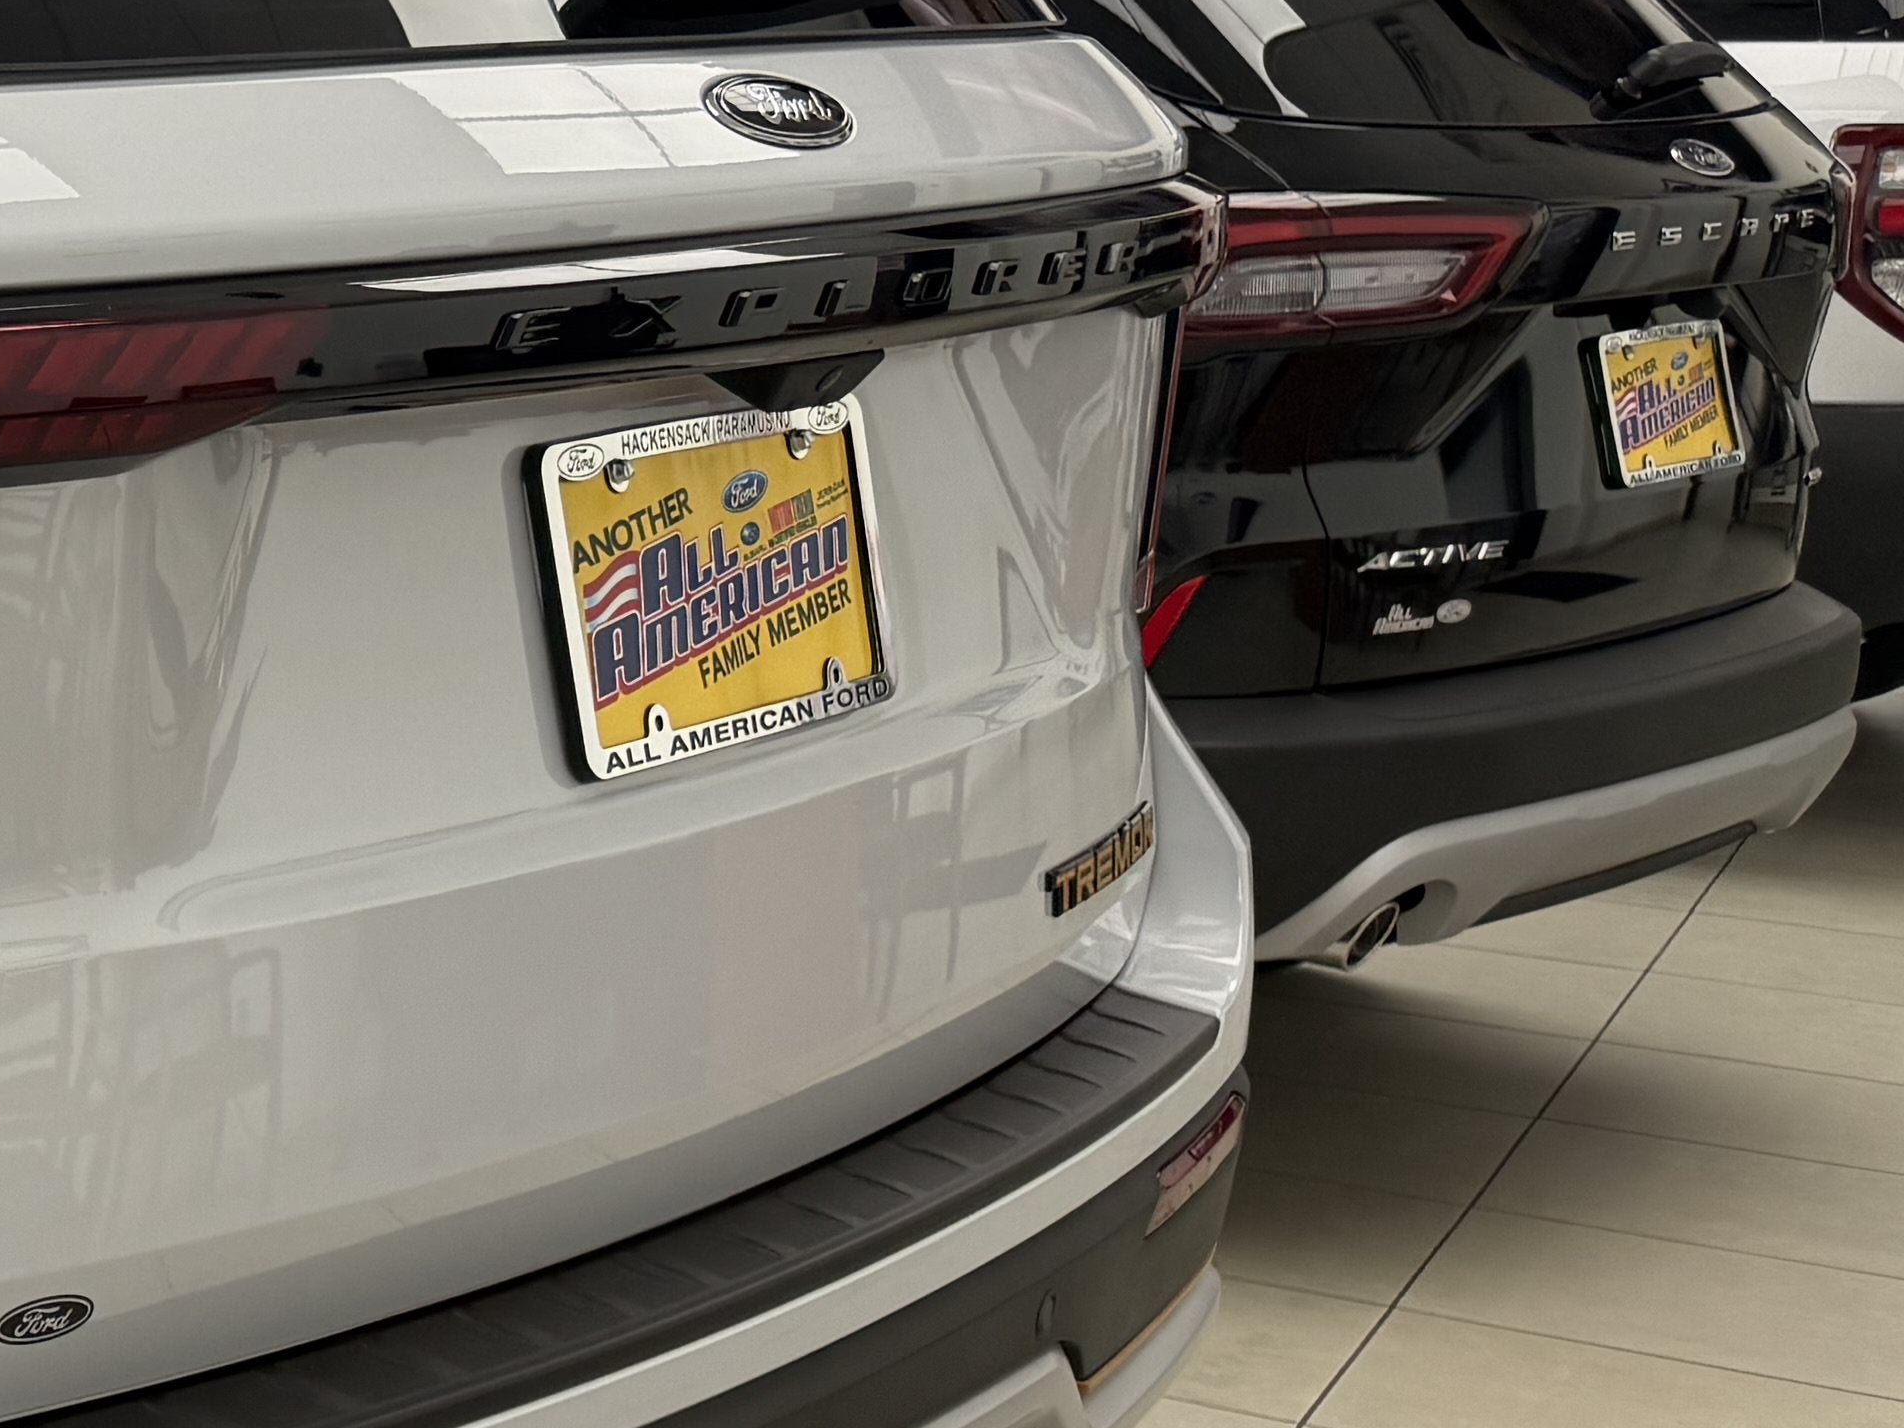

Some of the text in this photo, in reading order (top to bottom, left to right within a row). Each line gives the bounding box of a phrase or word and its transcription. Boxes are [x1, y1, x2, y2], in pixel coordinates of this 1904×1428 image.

[1612, 208, 1815, 252] ESCAPE
[493, 240, 1137, 354] EXPLORER
[1612, 357, 1658, 394] ANOTHER
[1638, 377, 1677, 415] ALL
[1619, 378, 1716, 452] AMERICAN
[621, 419, 710, 456] HACKENSACK
[566, 448, 596, 473] Ford
[730, 477, 759, 508] Ford
[573, 487, 693, 572] ANOTHER
[640, 524, 740, 621] ALL
[1357, 540, 1510, 573] ACTIVE
[593, 514, 849, 703] AMERICAN
[698, 578, 852, 689] FAMILY MEMBER
[606, 678, 889, 774] ALL AMERICAN FORD
[14, 1306, 71, 1338] Ford
